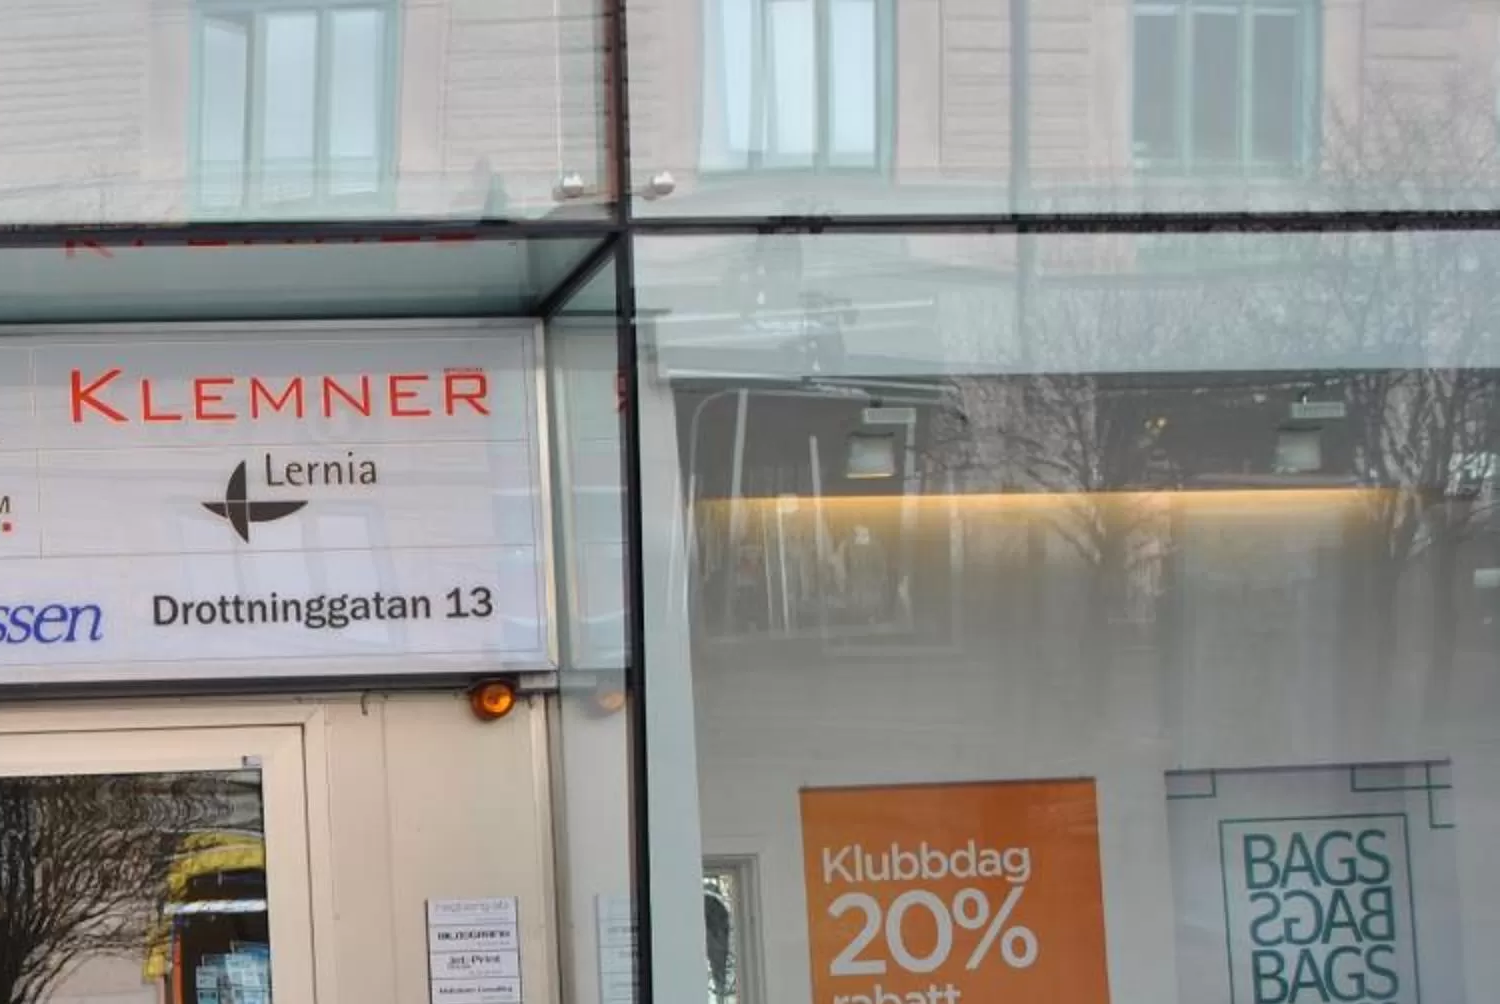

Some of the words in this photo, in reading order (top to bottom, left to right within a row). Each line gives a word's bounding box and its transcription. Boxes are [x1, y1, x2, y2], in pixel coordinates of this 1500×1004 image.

[69, 368, 492, 424] KLEMNER
[265, 452, 378, 487] Lernia
[152, 590, 432, 628] Drottninggatan
[445, 587, 494, 618] 13
[821, 839, 1031, 884] Klubbdag
[1243, 829, 1391, 889] BAGS
[827, 885, 1039, 977] 20%
